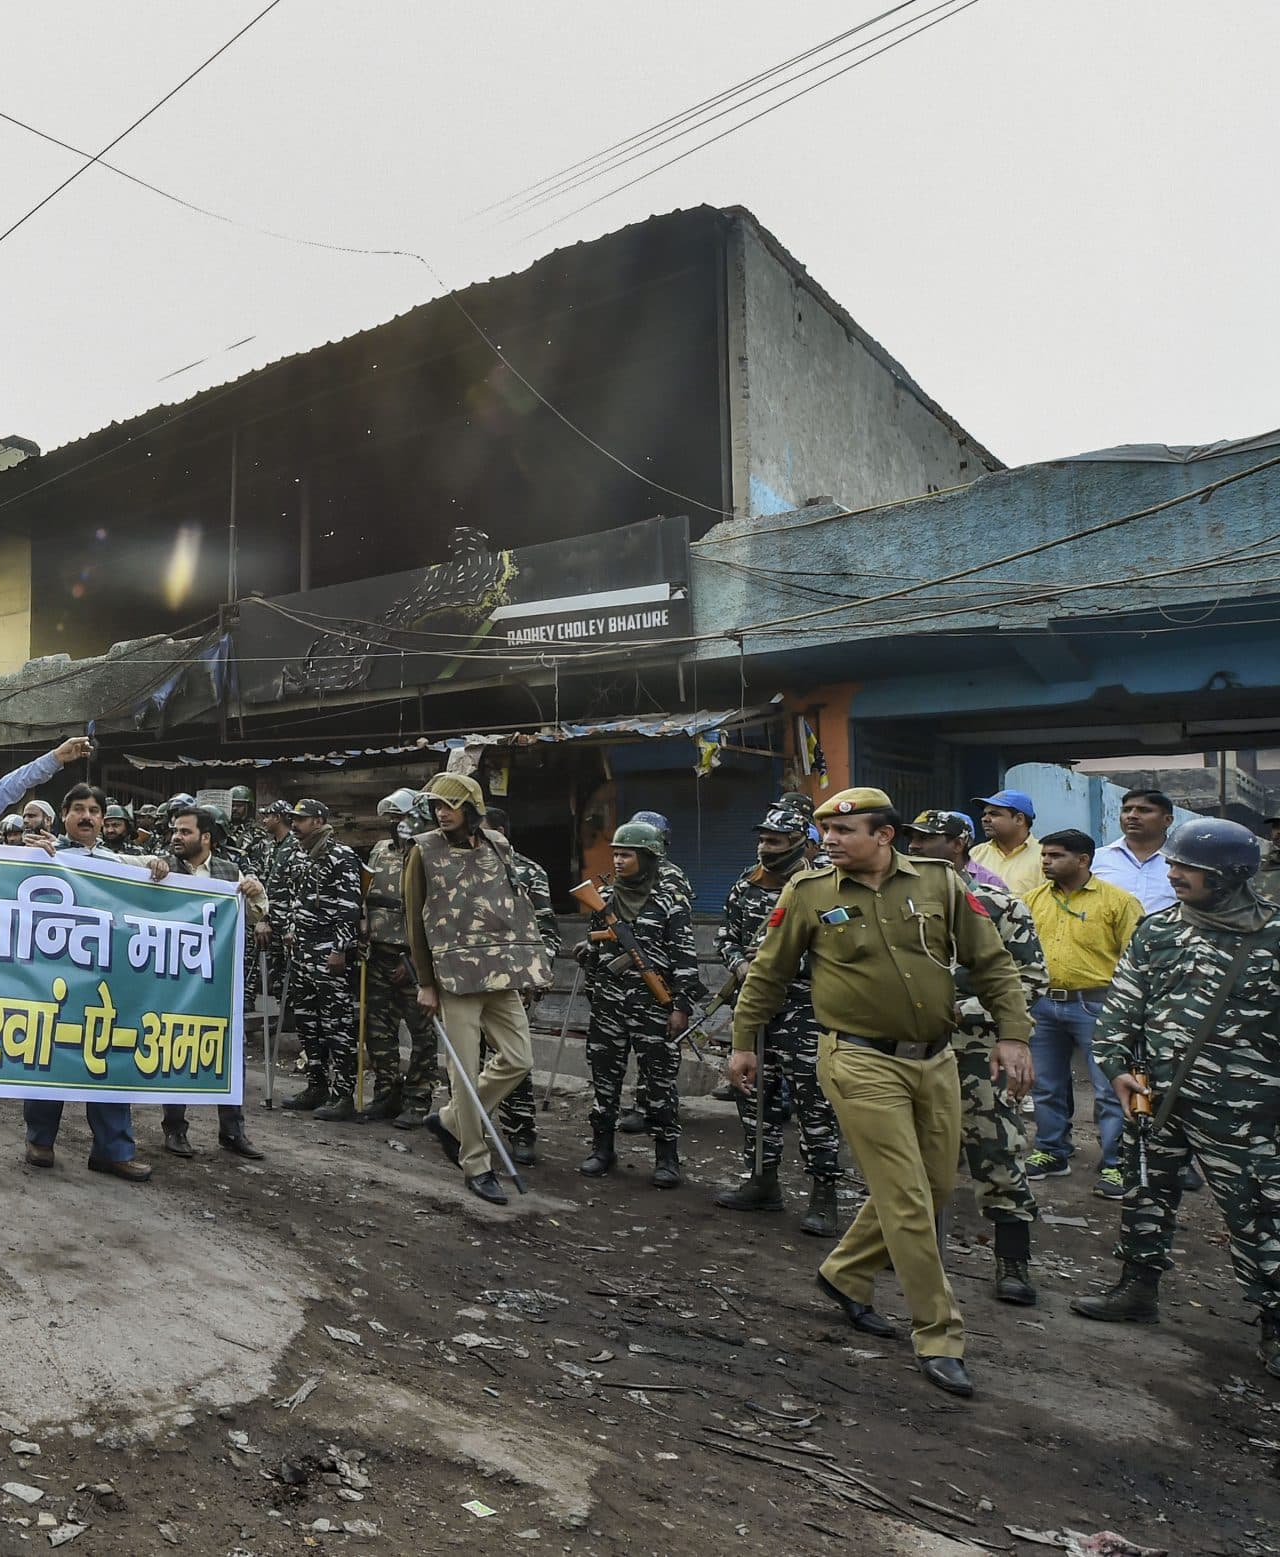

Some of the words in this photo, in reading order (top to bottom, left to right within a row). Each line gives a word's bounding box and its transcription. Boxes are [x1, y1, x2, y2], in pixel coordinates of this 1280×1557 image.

[506, 623, 555, 647] RADHEY
[557, 616, 605, 640] CHOLEY
[608, 609, 669, 634] BHATURE
[123, 902, 217, 980] मार्च
